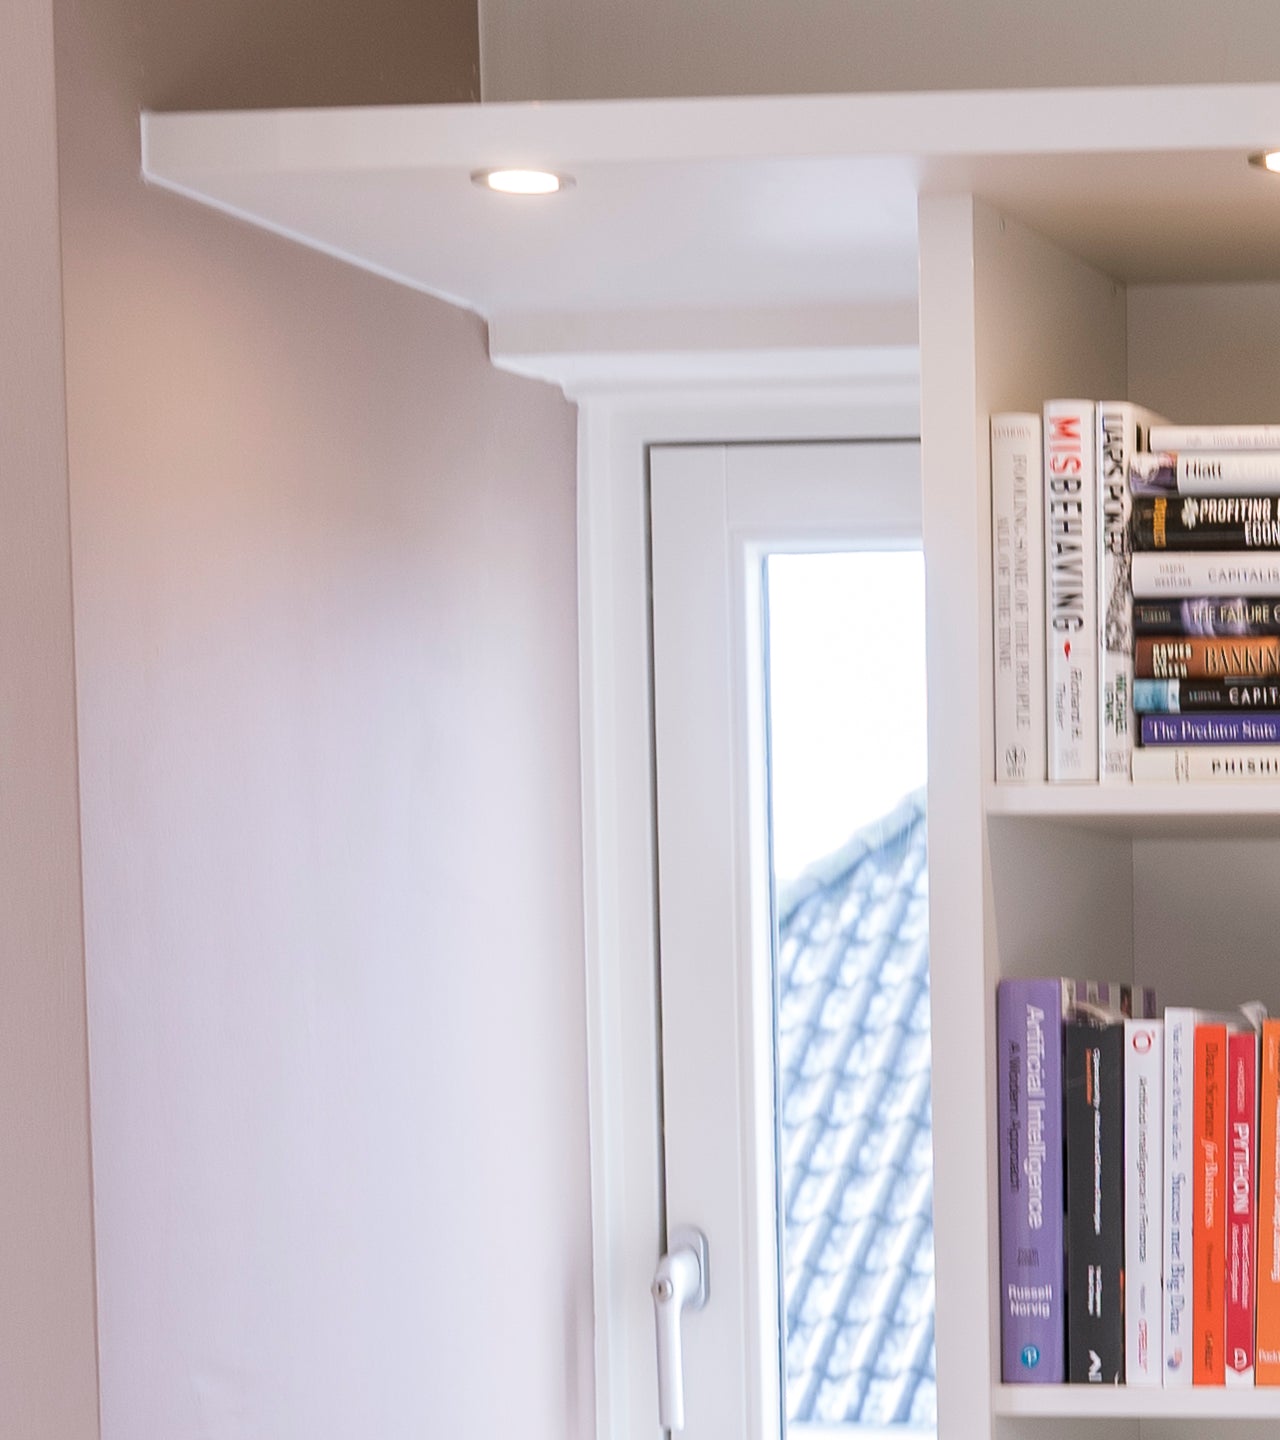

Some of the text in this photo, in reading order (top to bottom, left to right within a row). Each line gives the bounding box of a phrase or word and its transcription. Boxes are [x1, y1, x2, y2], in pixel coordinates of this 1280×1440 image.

[1200, 497, 1271, 522] PROFITING
[1049, 415, 1083, 633] MISBEHAVING
[1192, 605, 1216, 623] THE
[1220, 604, 1270, 623] FAILURE
[1149, 721, 1178, 740] The
[1181, 720, 1238, 741] Predator
[1242, 720, 1277, 740] State
[1023, 1004, 1048, 1230] Artificial Intelligence
[1232, 1122, 1250, 1214] PYTHON
[1008, 1285, 1052, 1300] Russell
[1010, 1301, 1050, 1319] Norvig
